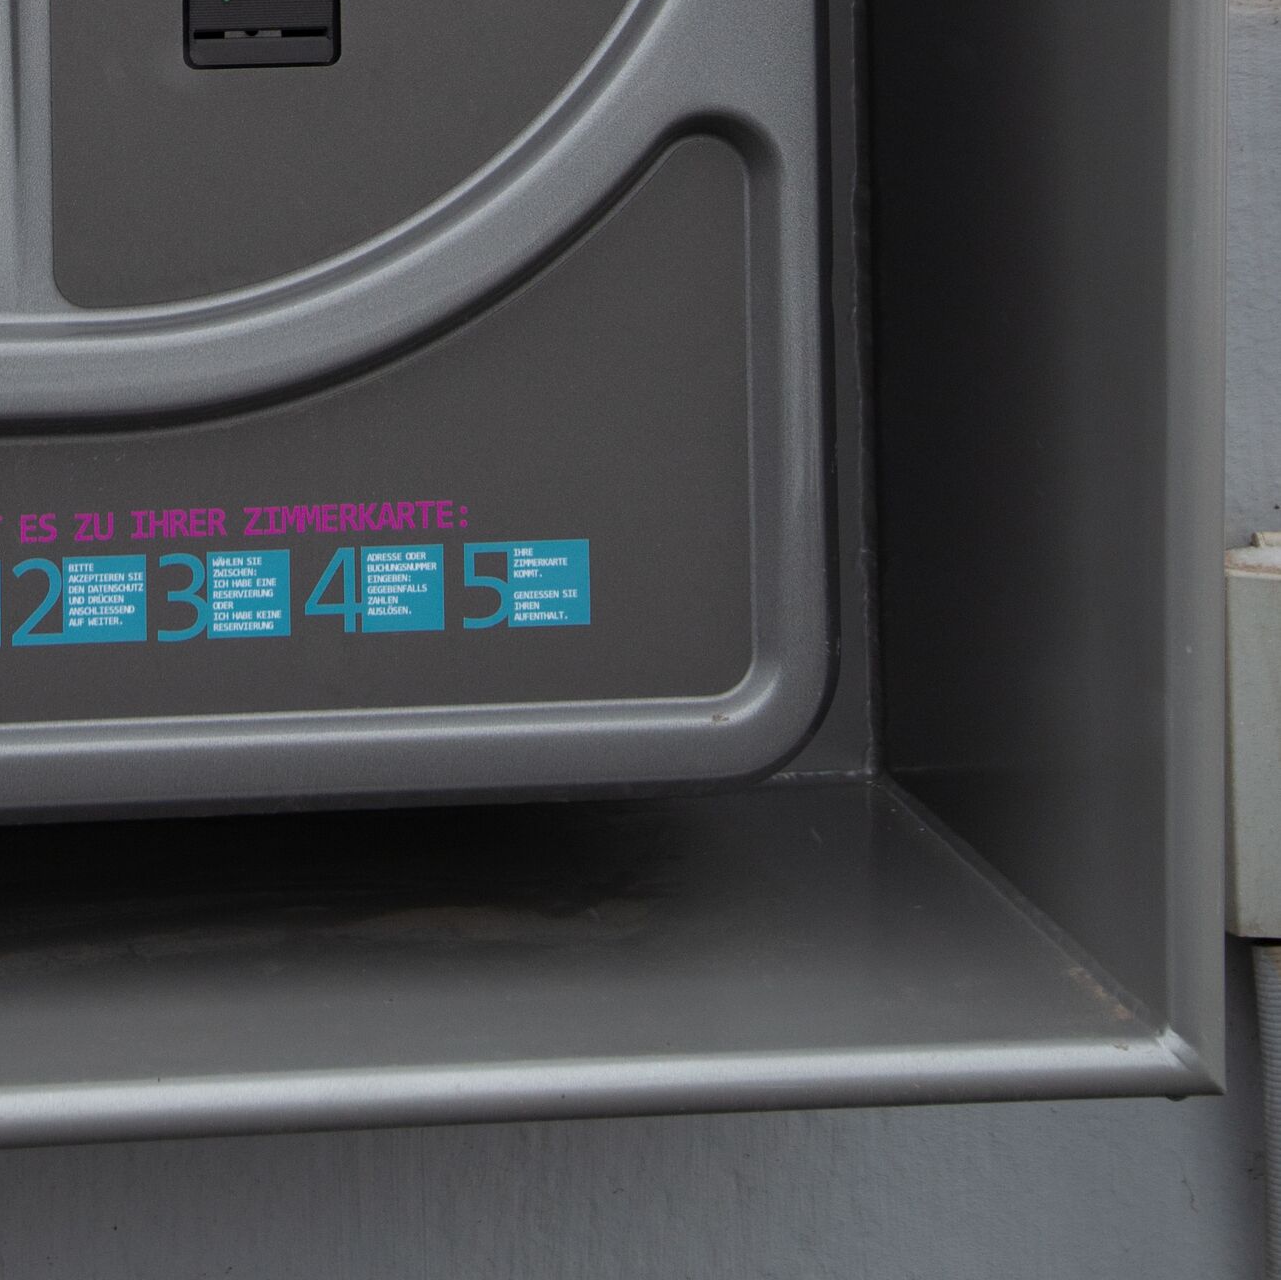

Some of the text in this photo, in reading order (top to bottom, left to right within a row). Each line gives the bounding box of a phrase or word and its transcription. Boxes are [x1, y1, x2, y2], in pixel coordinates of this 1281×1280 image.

[19, 513, 58, 544] ES
[73, 511, 114, 541] ZU
[130, 508, 228, 539] IHRER
[243, 500, 468, 536] ZIMMERKARTE:
[367, 551, 427, 562] ADRESSE ODER
[513, 548, 533, 557] IHRE
[68, 563, 94, 572] BITTE
[212, 557, 262, 567] WÄHLEN SIE
[367, 562, 437, 573] BUCHUNGSNUMMER
[513, 557, 568, 568] ZIMMERKARTE
[68, 572, 144, 584] AKZEPTIEREN SIE
[213, 568, 257, 577] ZWISCHEN:
[513, 569, 543, 578] KOMMT.
[213, 578, 277, 588] ICH HABE EINE
[367, 574, 412, 584] EINGEBEN:
[68, 583, 144, 594] DEN DATENSCHUTZ
[305, 547, 361, 633] 4
[367, 583, 428, 594] GEGEBENFALLS
[463, 542, 508, 629] 5
[68, 594, 125, 605] UND DRÜCKEN
[157, 552, 208, 642] 3
[213, 589, 274, 599] RESERVIERUNG
[513, 589, 578, 600] GENIESSEN SIE
[12, 557, 64, 646] 2
[212, 601, 234, 610] ODER
[367, 595, 399, 605] ZAHLEN
[514, 601, 540, 610] IHREN
[68, 605, 136, 616] ANSCHLIESSEND
[213, 610, 282, 621] ICH HABE KEINE
[367, 605, 412, 616] AUSLÖSEN.
[514, 611, 568, 621] AUFENTHALT.
[68, 617, 123, 627] AUF WEITER.
[213, 621, 274, 632] RESERVIERUNG
